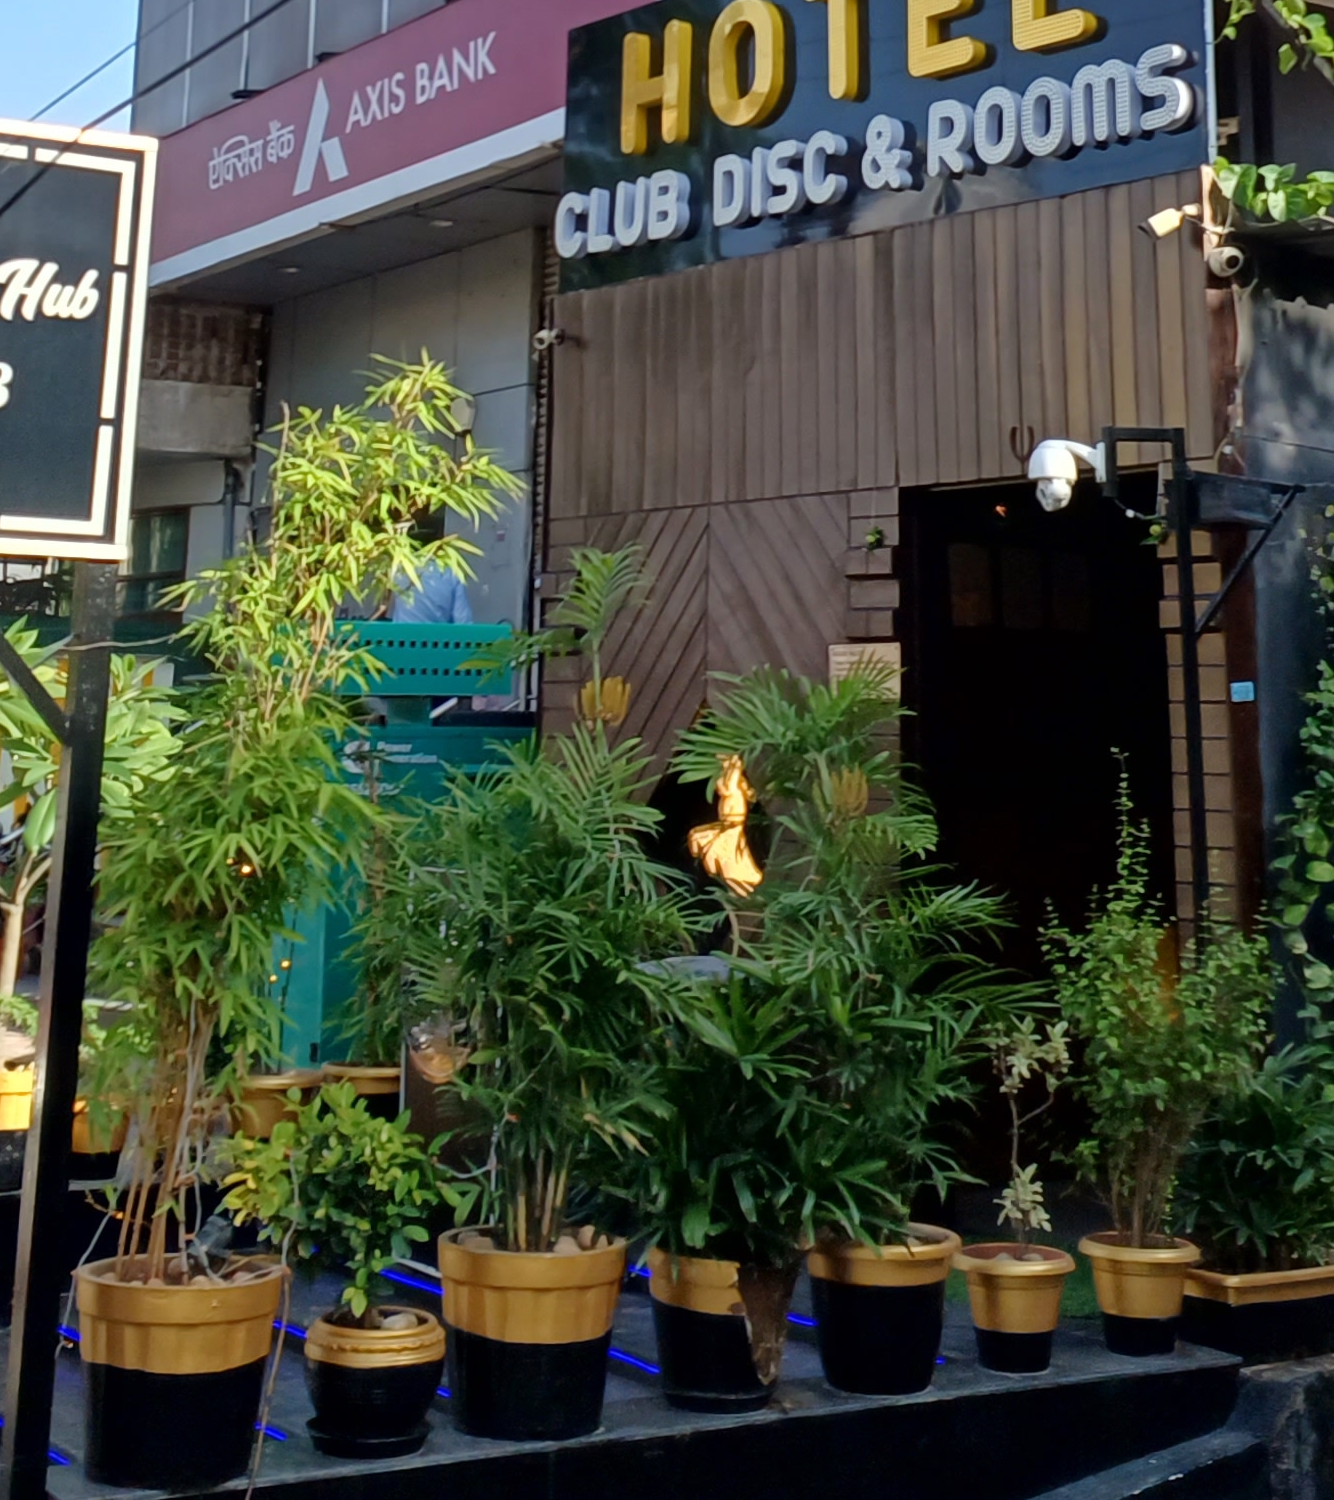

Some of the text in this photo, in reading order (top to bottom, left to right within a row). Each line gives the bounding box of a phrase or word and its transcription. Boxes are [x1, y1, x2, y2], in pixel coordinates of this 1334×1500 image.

[345, 31, 497, 134] AXIS BANK
[208, 119, 295, 190] ऐक्सिस बैंक
[555, 169, 691, 259] CLUB
[713, 130, 849, 227] DISC
[861, 114, 913, 190] &
